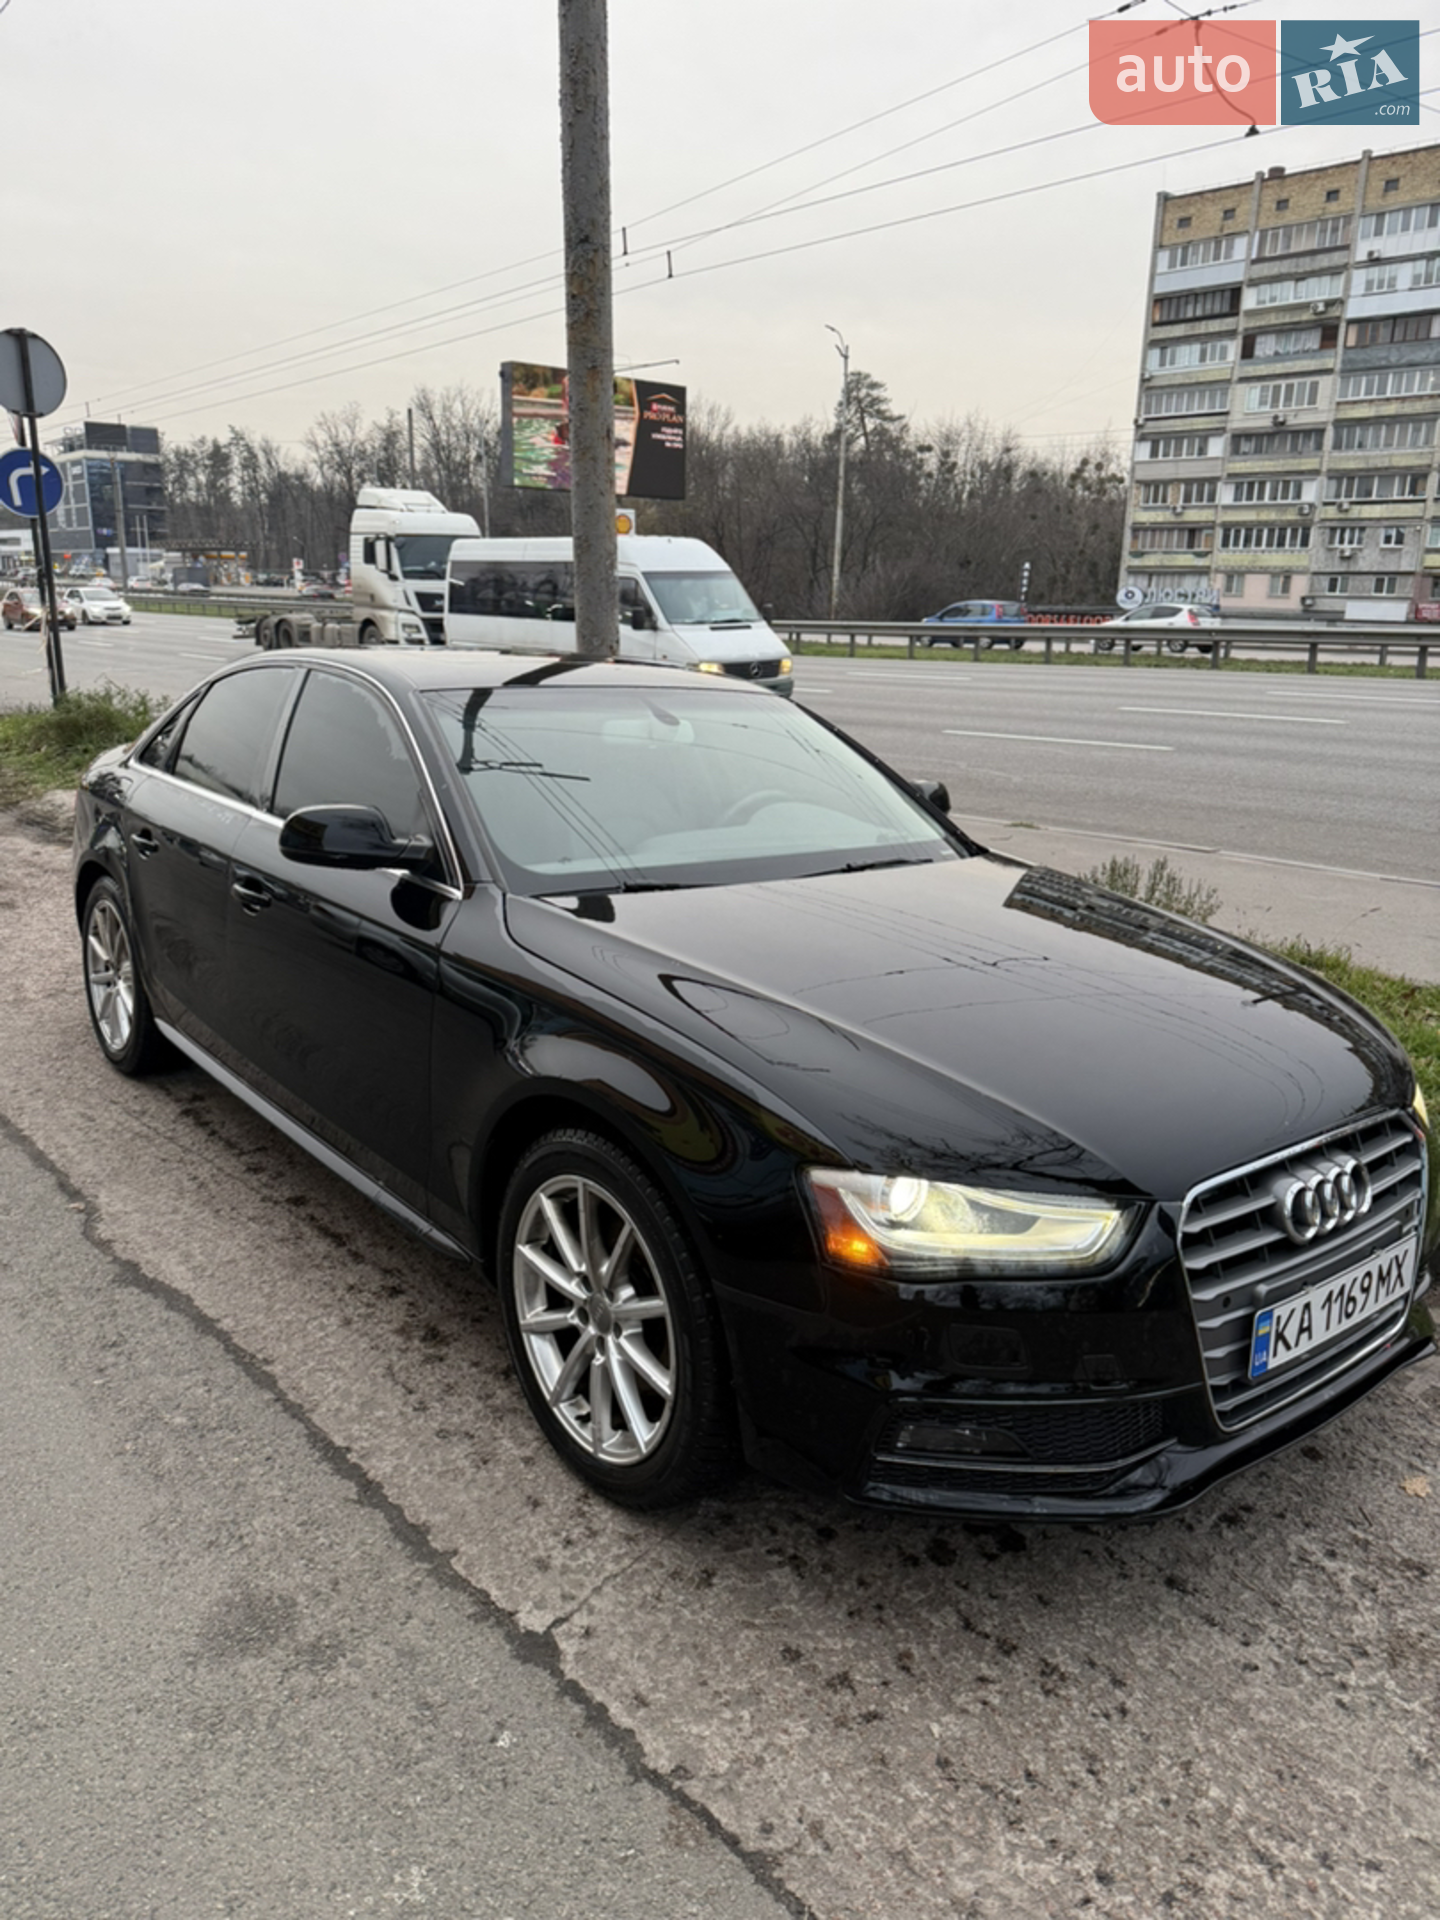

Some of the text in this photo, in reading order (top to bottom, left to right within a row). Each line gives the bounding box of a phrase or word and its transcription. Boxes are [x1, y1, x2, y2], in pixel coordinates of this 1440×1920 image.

[1272, 1249, 1409, 1359] KA 1169 MX
[1254, 1351, 1268, 1367] UA
